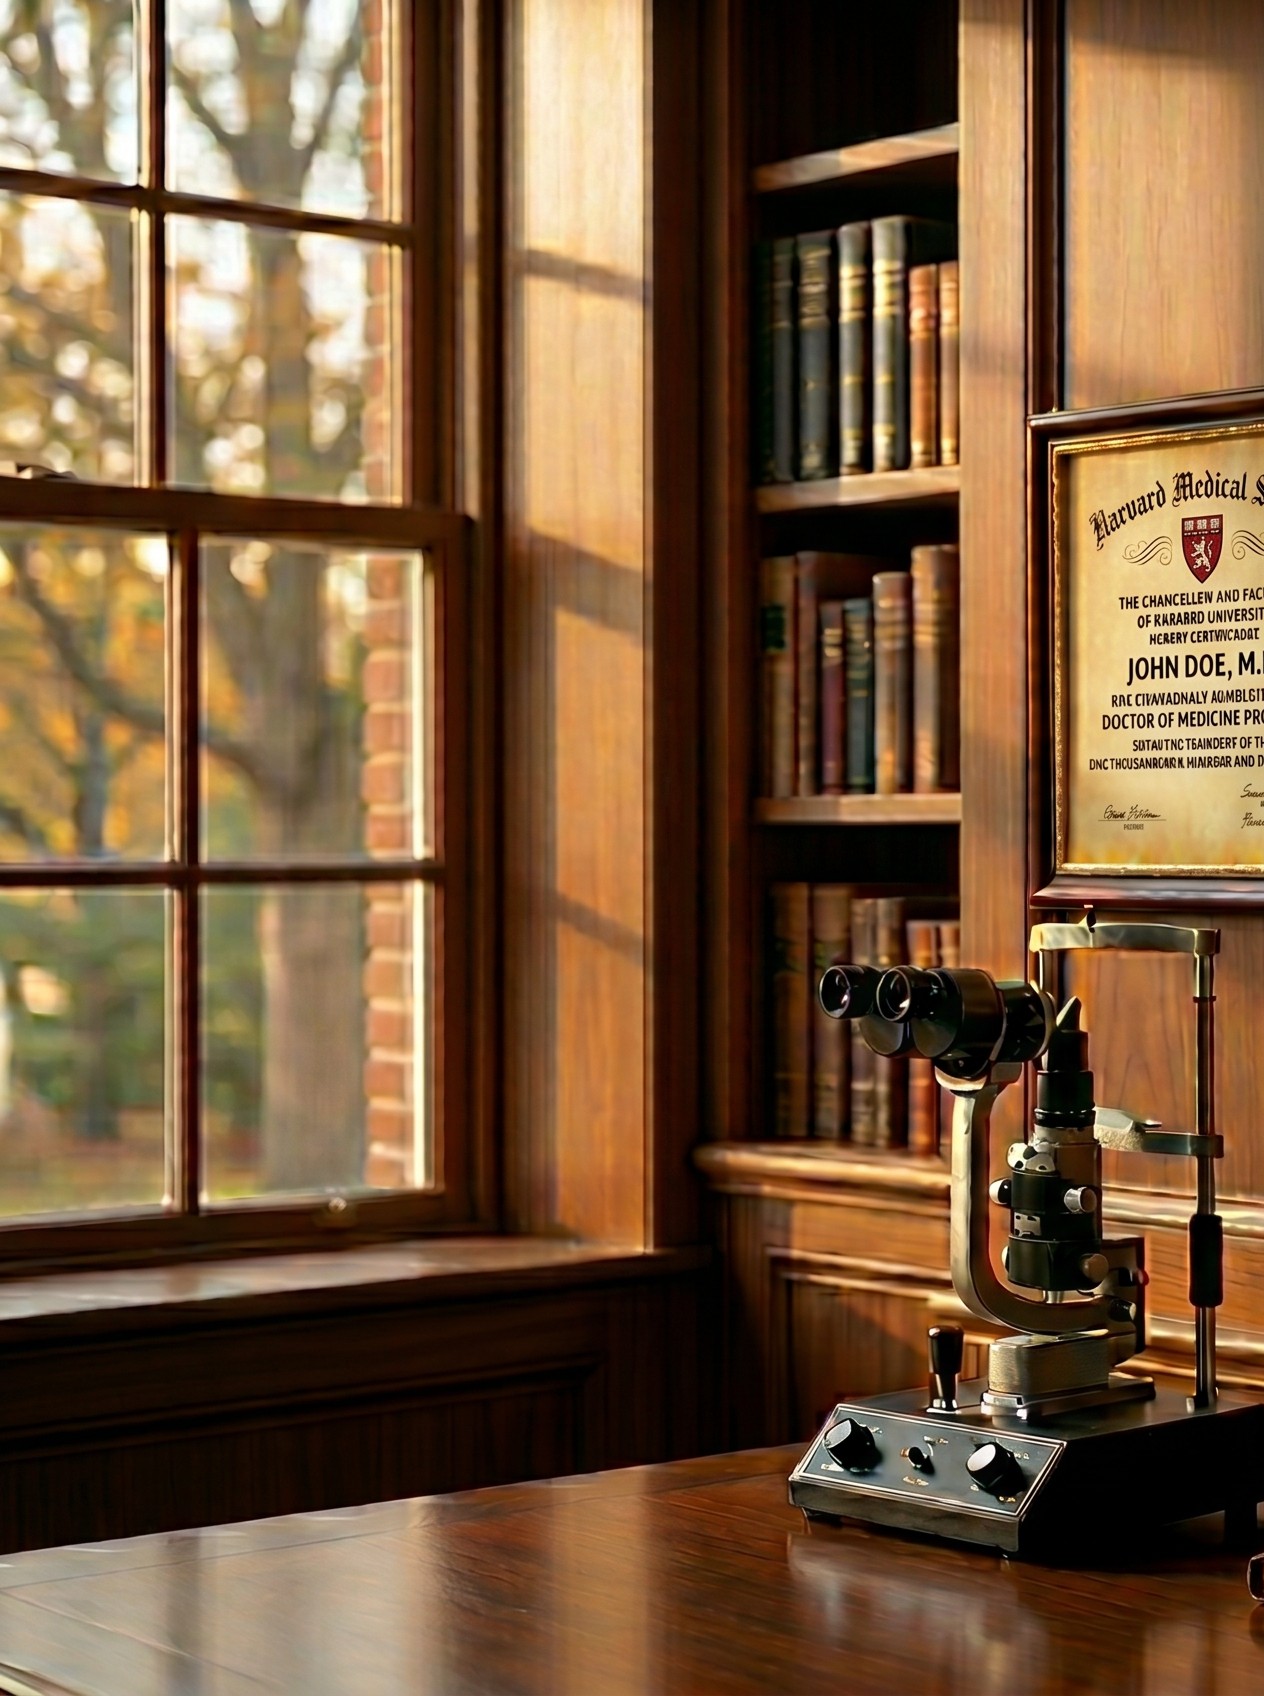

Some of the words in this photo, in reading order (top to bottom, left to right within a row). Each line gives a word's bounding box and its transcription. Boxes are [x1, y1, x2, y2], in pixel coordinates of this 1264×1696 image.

[1089, 480, 1166, 552] Harvard
[1172, 470, 1248, 507] Medical
[1119, 596, 1139, 610] THE
[1216, 589, 1239, 602] AND
[1137, 615, 1151, 628] OF
[1127, 655, 1178, 686] JOHN
[1185, 653, 1232, 680] DOE,
[1102, 713, 1154, 729] DOCTOR
[1158, 713, 1175, 728] OF
[1178, 709, 1240, 727] MEDICINE
[1240, 736, 1253, 748] OF
[1234, 754, 1255, 767] AND
